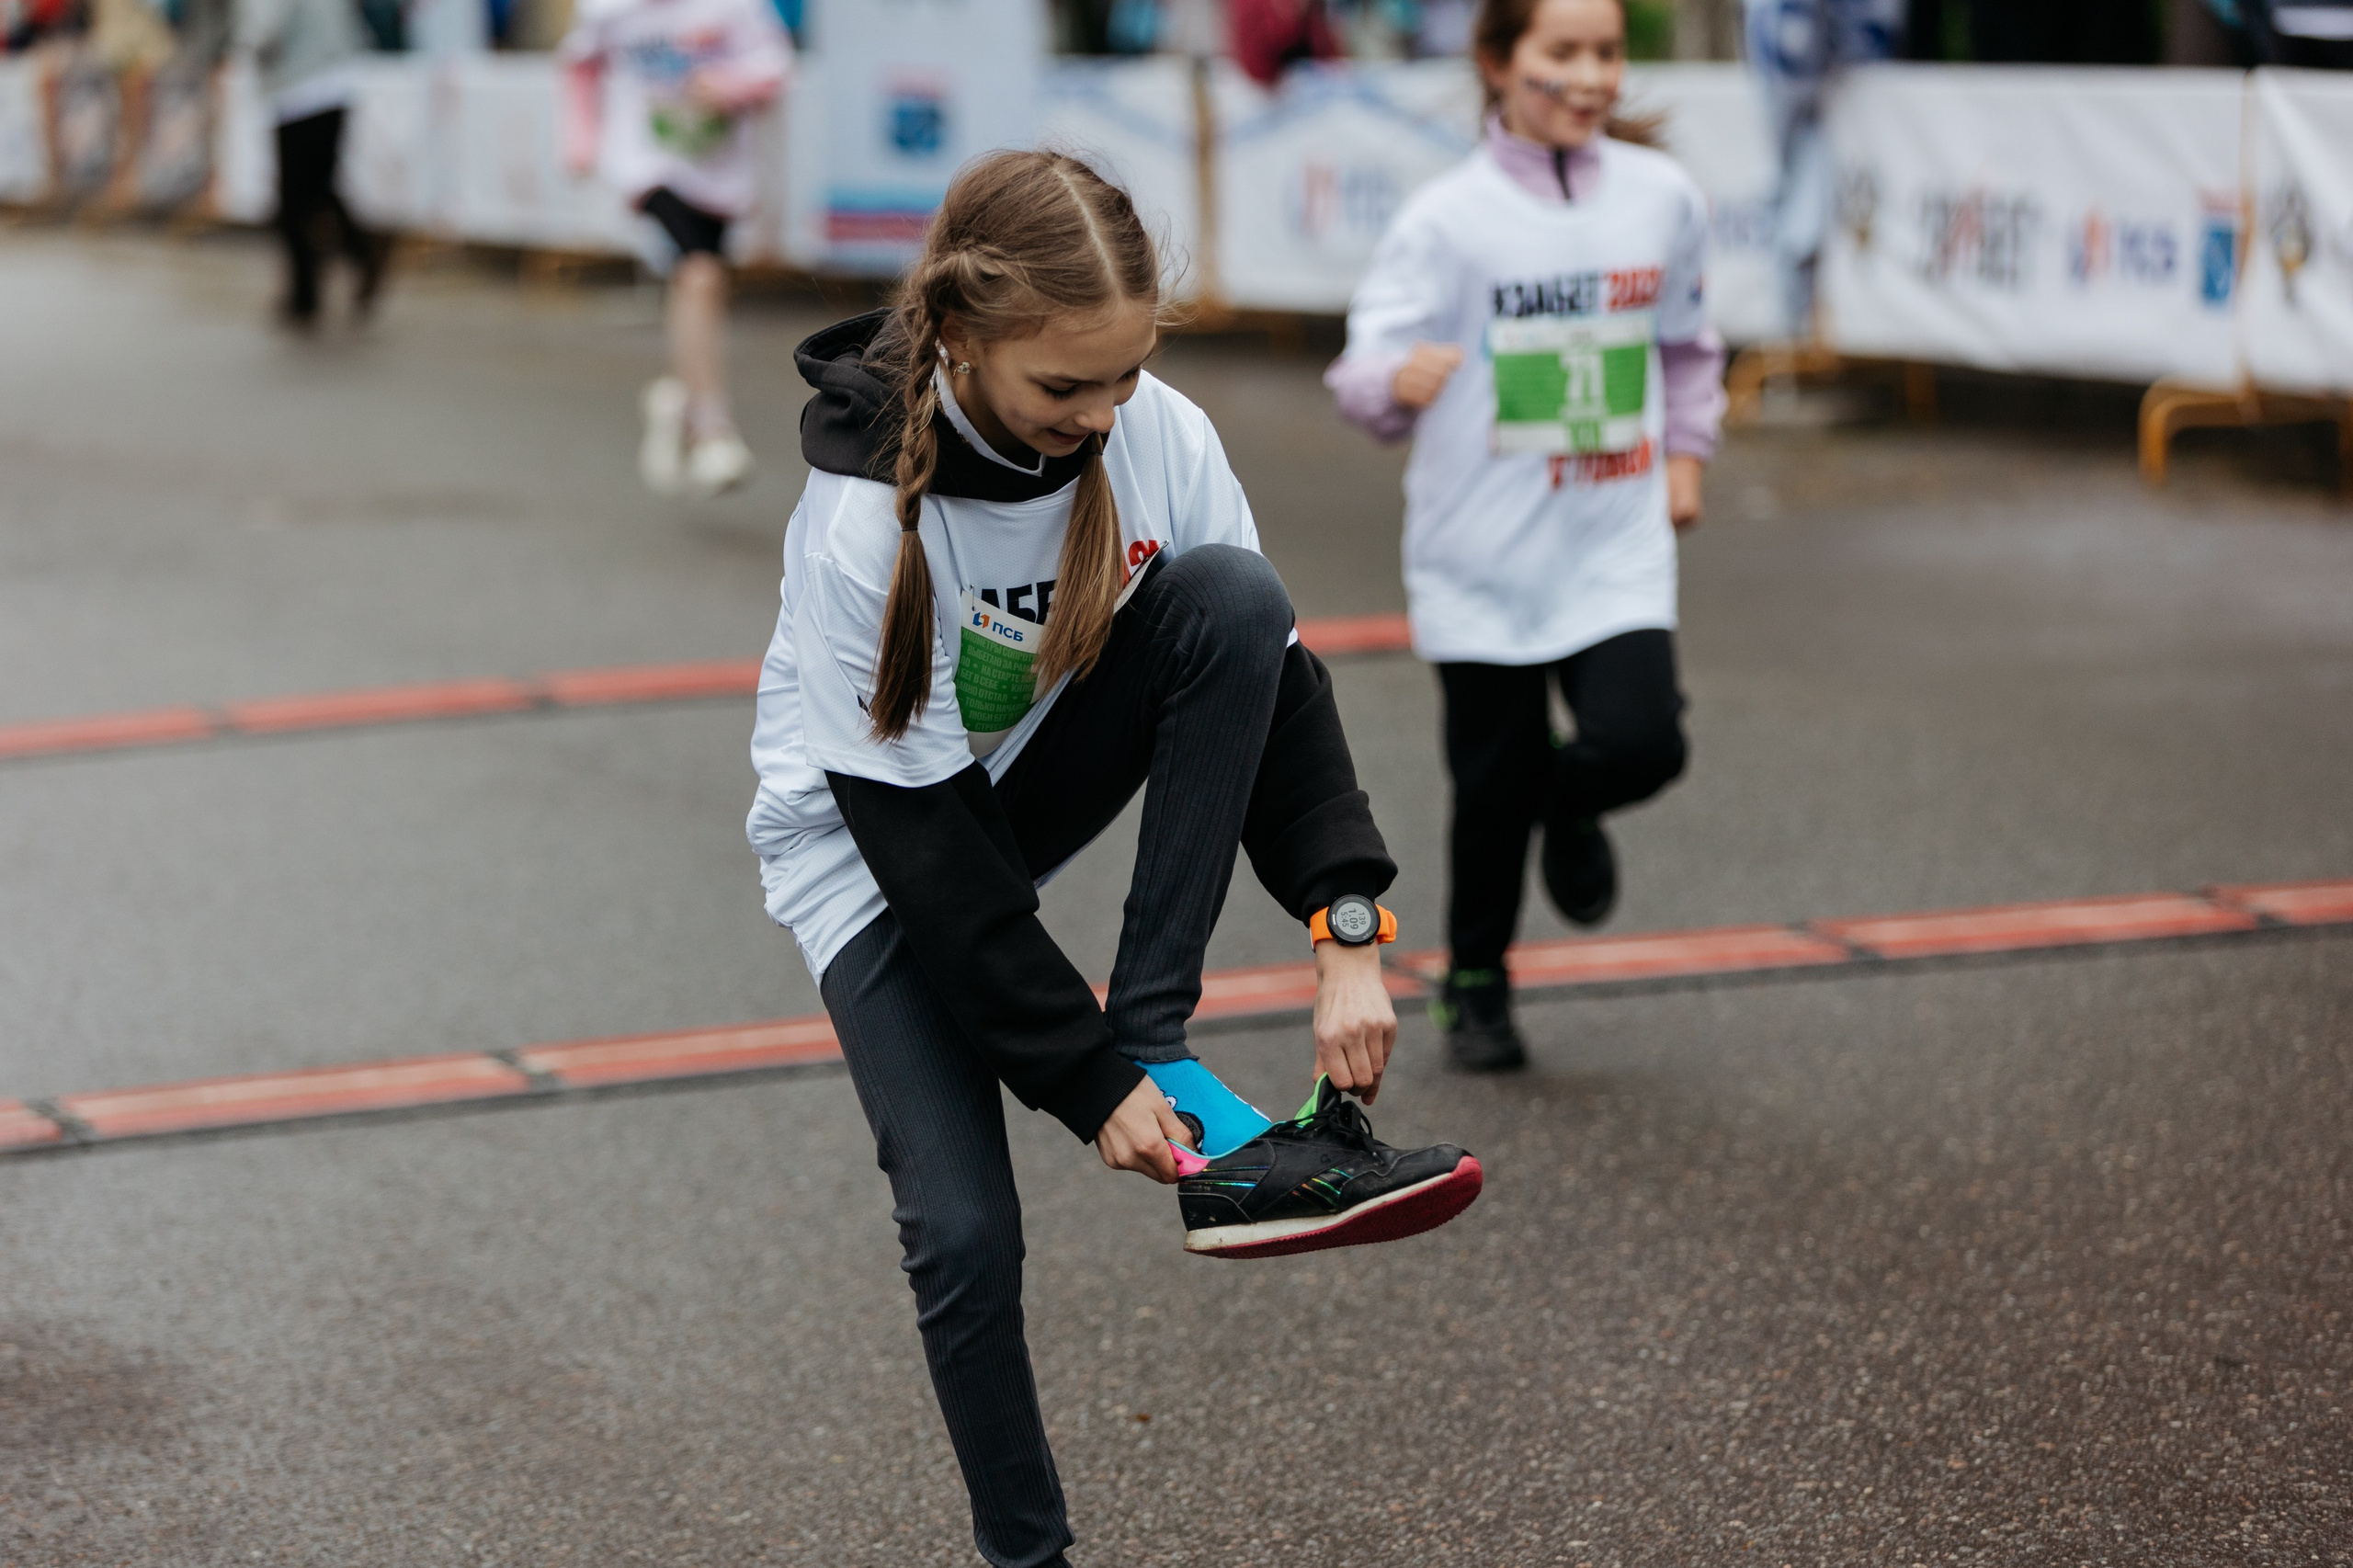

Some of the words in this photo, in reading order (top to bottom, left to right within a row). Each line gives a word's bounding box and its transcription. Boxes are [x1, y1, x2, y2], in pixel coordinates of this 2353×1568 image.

[992, 621, 1023, 642] ПСБ
[967, 644, 1002, 667] ВЫБЕГАЮ
[1003, 659, 1013, 670] ЗА
[1003, 644, 1034, 662] СОПРОТ
[961, 667, 973, 681] БЕГ
[979, 676, 999, 690] СЕБЕ
[981, 664, 991, 676] НА
[992, 668, 1019, 683] СТАРТЕ
[965, 696, 995, 712] ТОЛЬКО
[978, 688, 1007, 702] ОТСТАЛ
[969, 710, 993, 722] ЛЮБИ
[1348, 908, 1358, 930] 1.09
